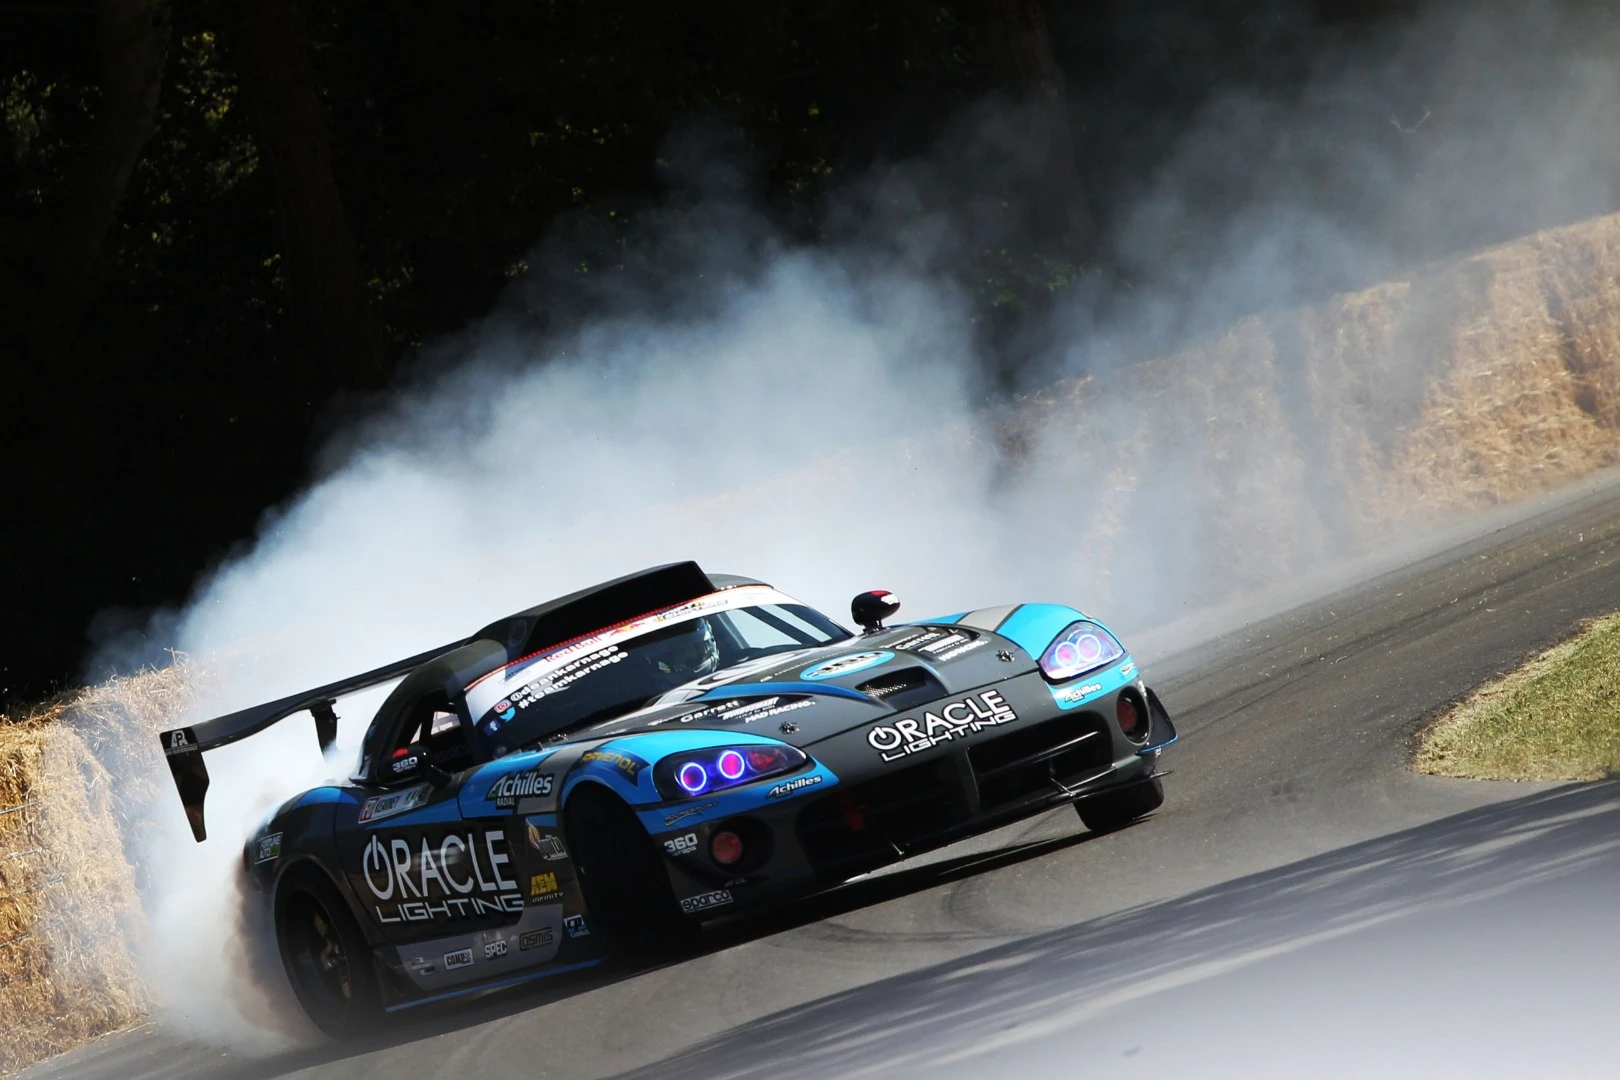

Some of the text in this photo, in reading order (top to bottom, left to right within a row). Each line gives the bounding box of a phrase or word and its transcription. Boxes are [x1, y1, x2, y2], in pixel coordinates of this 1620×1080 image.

[1064, 682, 1102, 702] Achilles
[680, 700, 739, 723] Garrett
[745, 711, 769, 724] MAD
[868, 690, 1011, 751] ORACLE
[881, 710, 1017, 762] LIGHTING
[392, 756, 418, 771] 360
[581, 751, 636, 776] RAVENOL
[487, 771, 553, 798] Achilles
[768, 775, 822, 797] Achilles
[496, 797, 515, 807] RADIAL
[664, 833, 698, 853] 360
[363, 830, 518, 900] ORACLE
[531, 871, 559, 896] AEM
[532, 891, 564, 903] INFINITY
[682, 889, 731, 911] sparco
[376, 894, 524, 923] LIGHTING
[484, 940, 507, 959] SPEC
